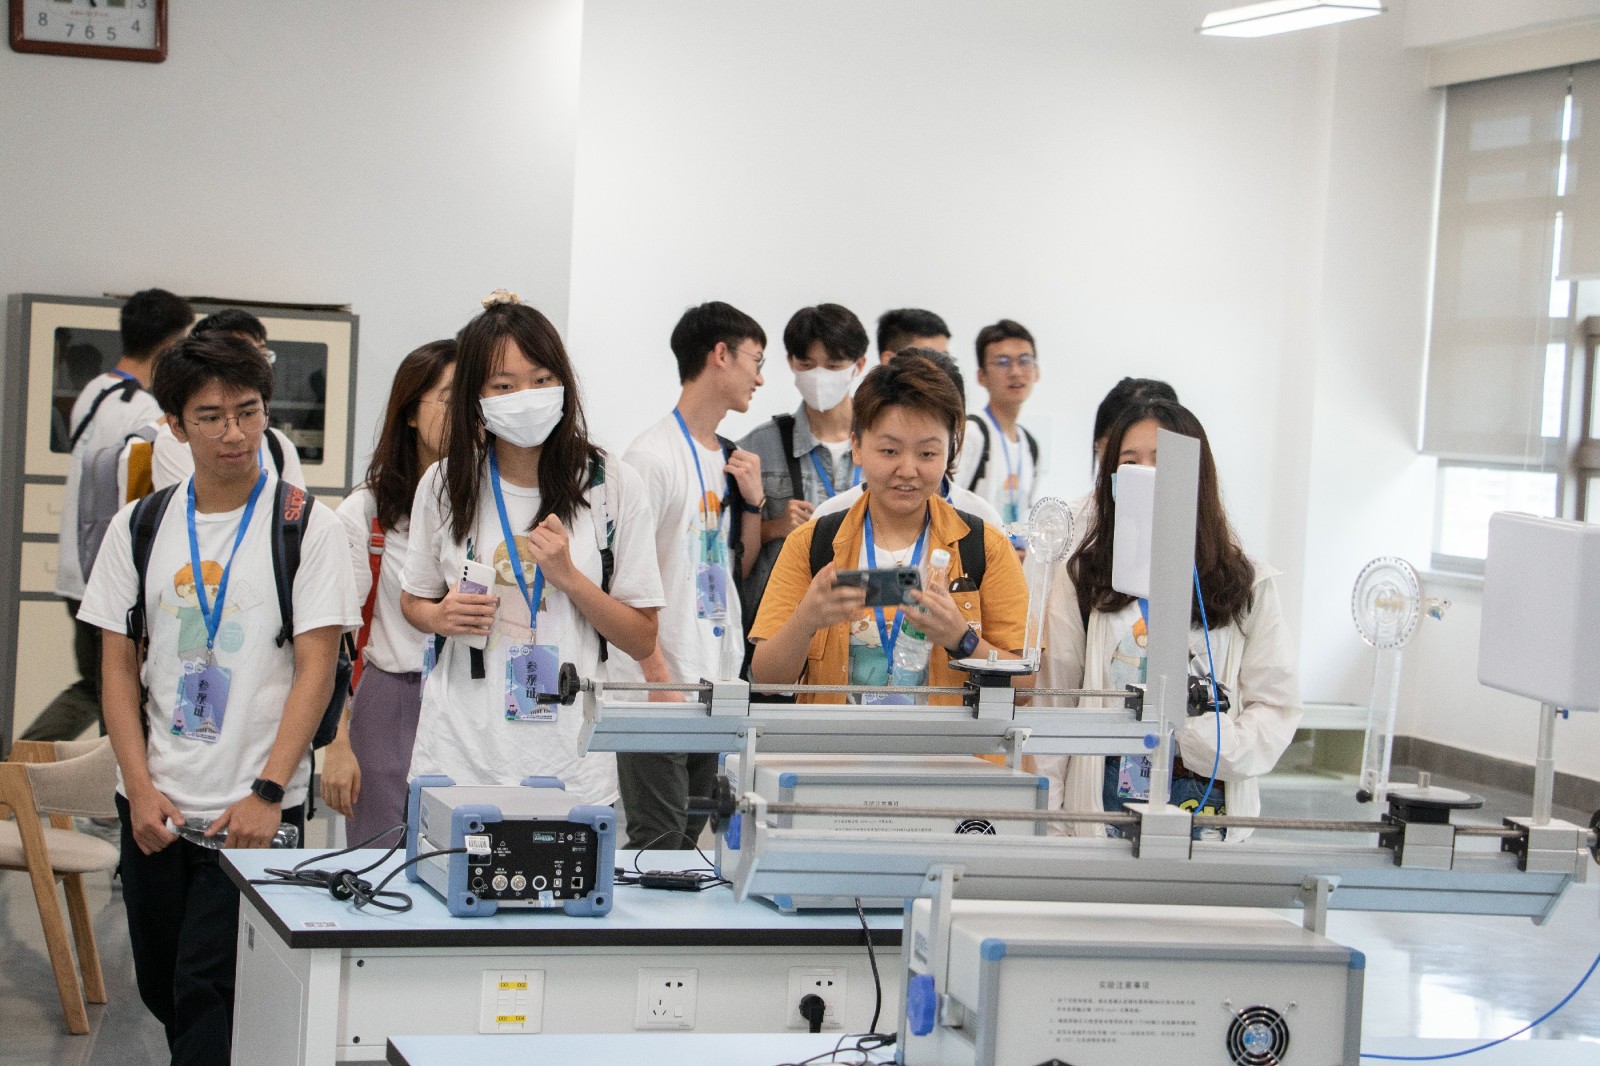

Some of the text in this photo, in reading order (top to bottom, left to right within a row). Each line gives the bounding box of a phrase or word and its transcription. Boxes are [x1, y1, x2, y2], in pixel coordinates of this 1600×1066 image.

[38, 12, 48, 26] 8
[131, 19, 141, 33] 4
[65, 24, 75, 38] 7
[85, 25, 95, 40] 6
[107, 27, 117, 41] 5
[525, 660, 538, 699] 参观证
[193, 679, 210, 718] 参观证
